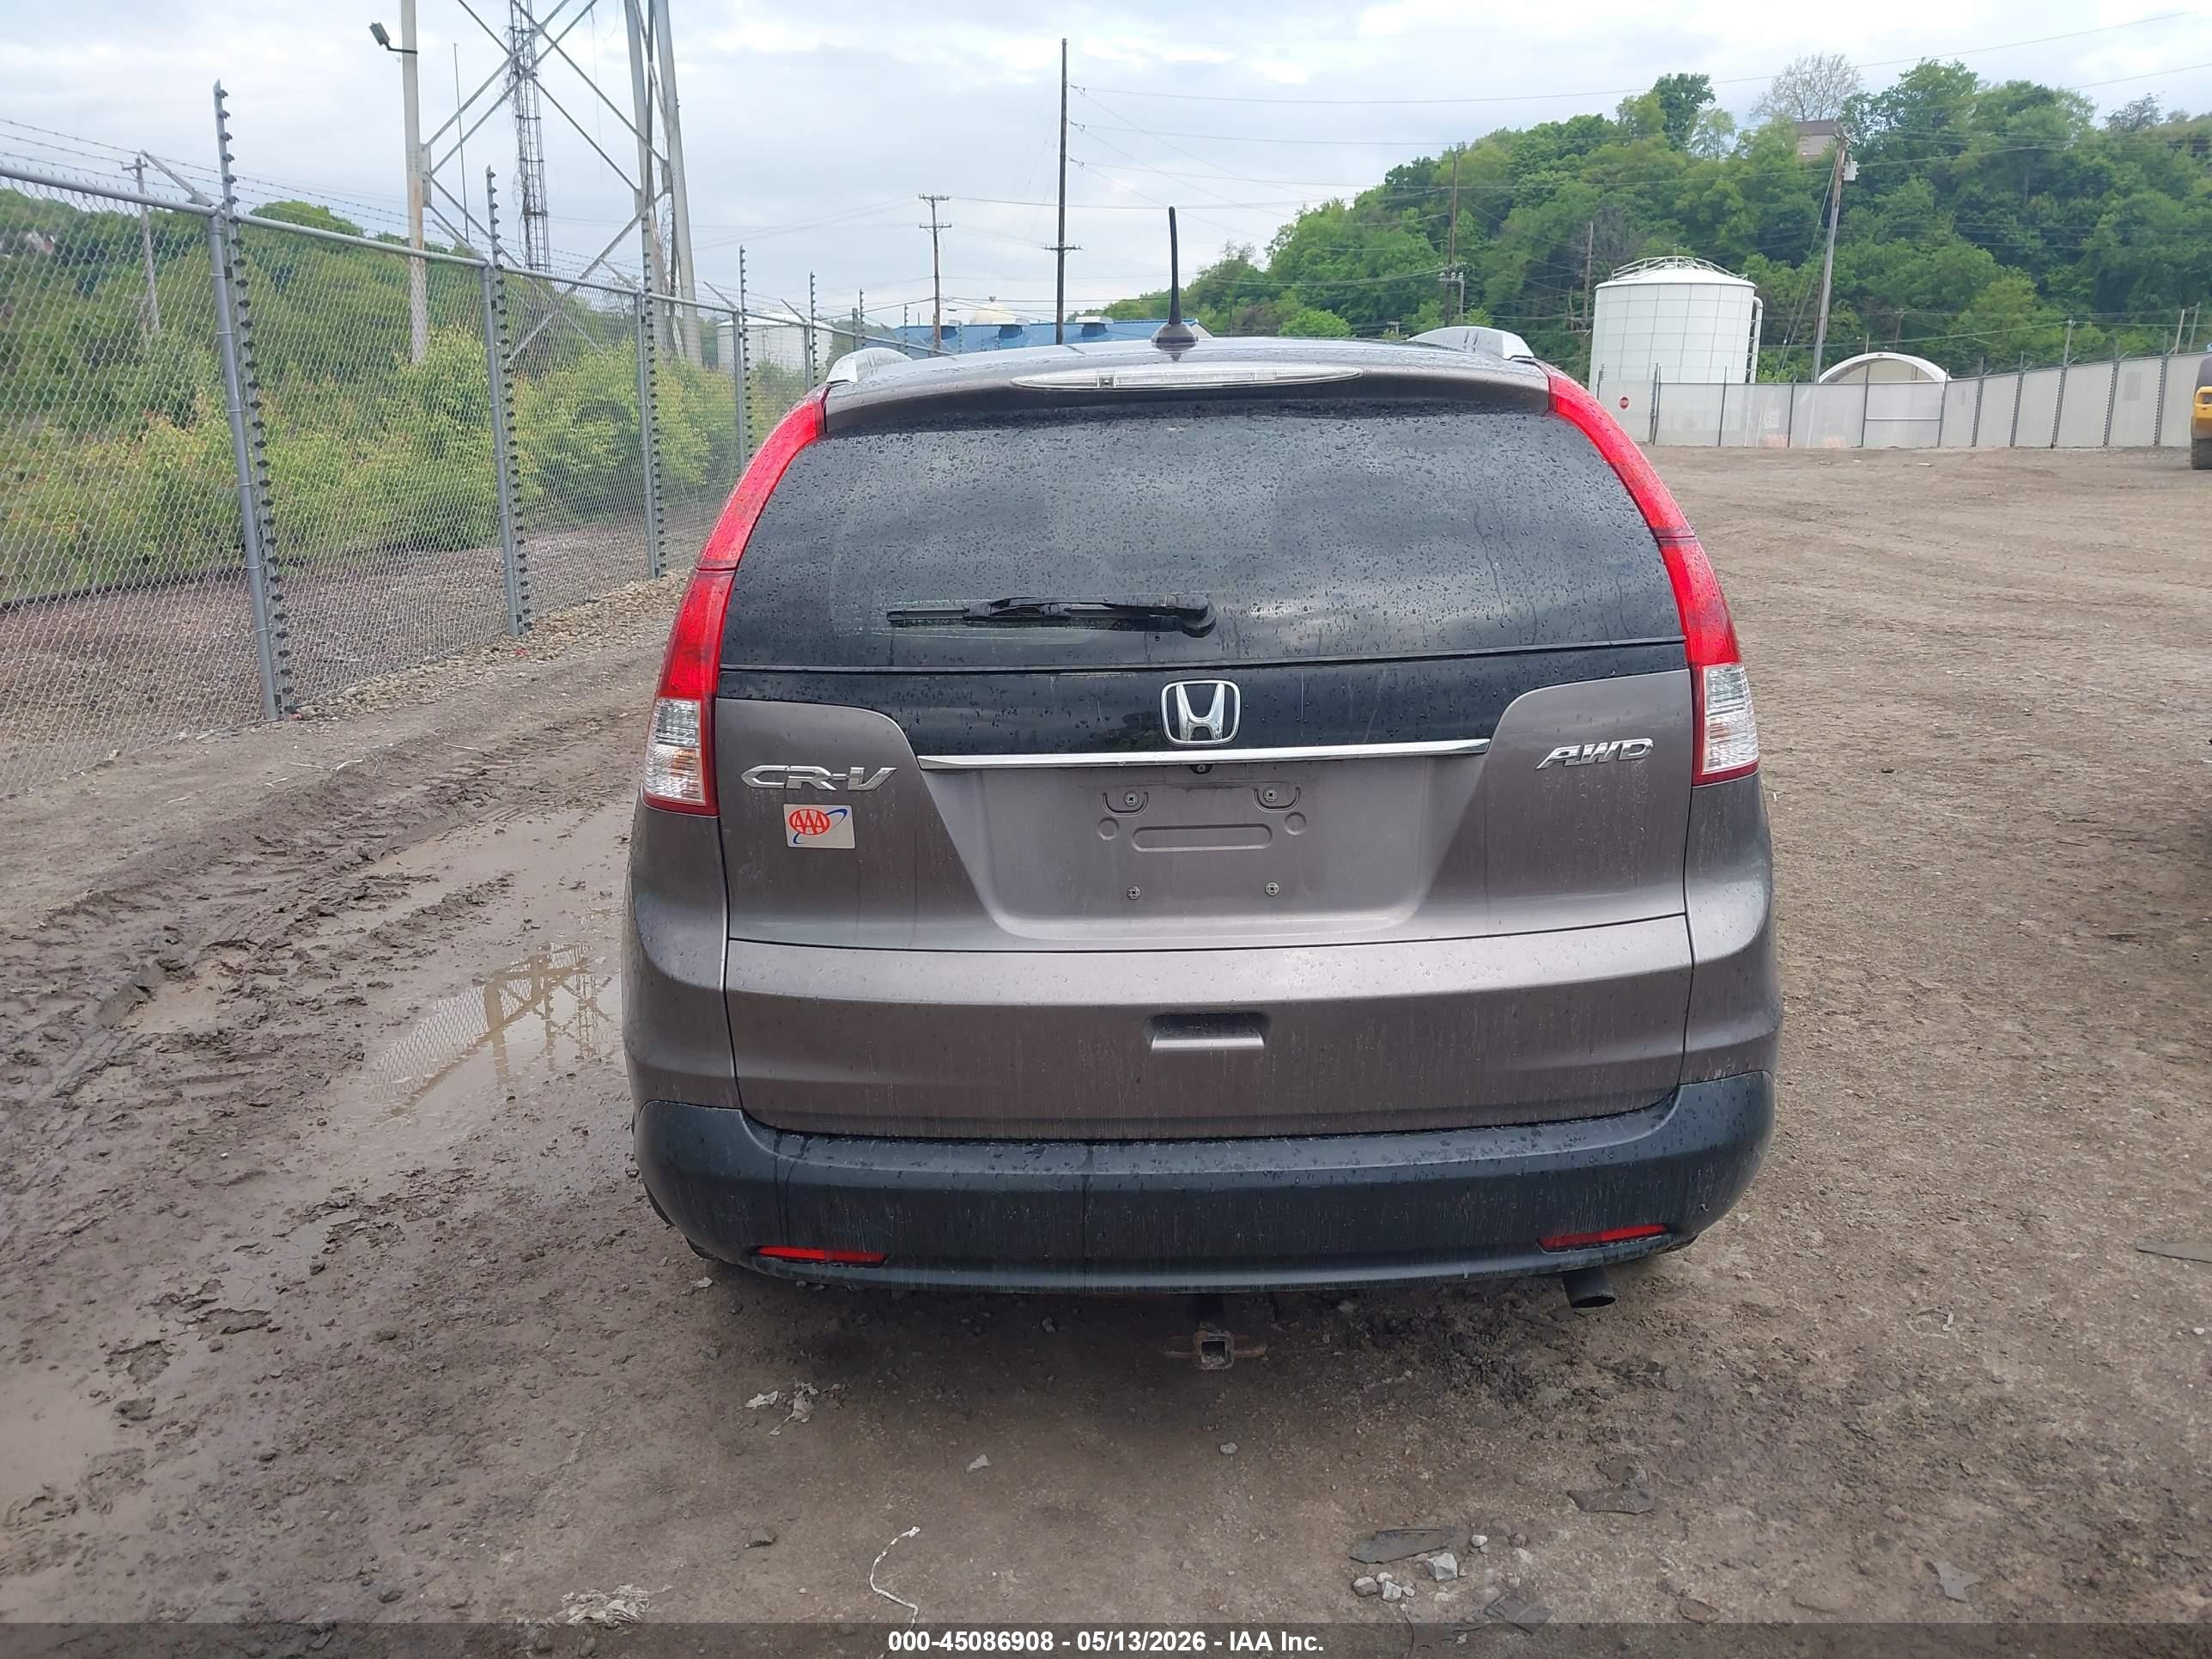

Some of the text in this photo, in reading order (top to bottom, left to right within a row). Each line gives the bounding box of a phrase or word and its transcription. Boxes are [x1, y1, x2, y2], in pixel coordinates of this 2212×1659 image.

[1535, 738, 1654, 769] AWD
[741, 764, 898, 791] CR-V
[794, 811, 826, 835] AAA
